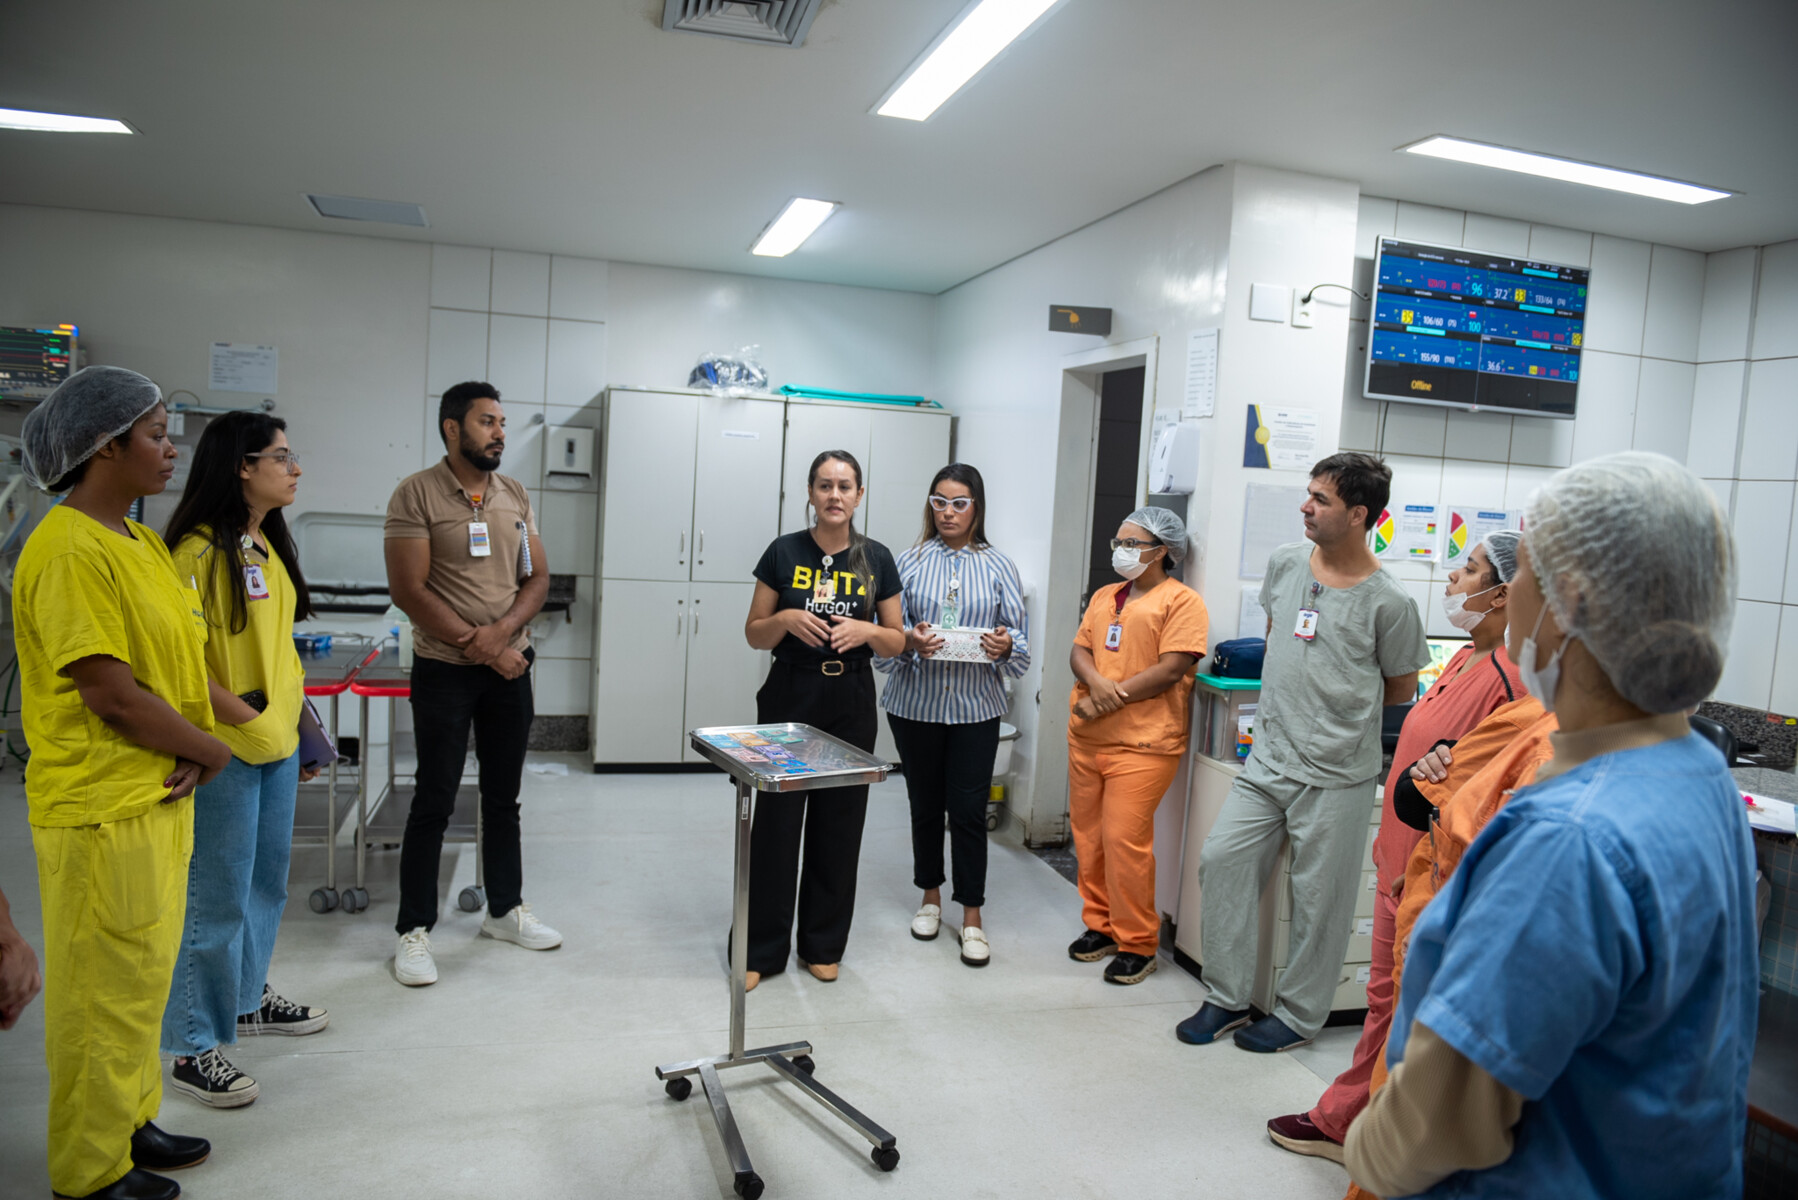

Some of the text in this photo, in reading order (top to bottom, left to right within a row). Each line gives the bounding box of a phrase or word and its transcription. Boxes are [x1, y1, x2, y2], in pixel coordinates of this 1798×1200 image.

[1472, 283, 1483, 296] 96
[1494, 288, 1509, 300] 37.2
[1423, 316, 1443, 327] 106/60
[1469, 321, 1481, 332] 100
[1411, 380, 1432, 391] Offline
